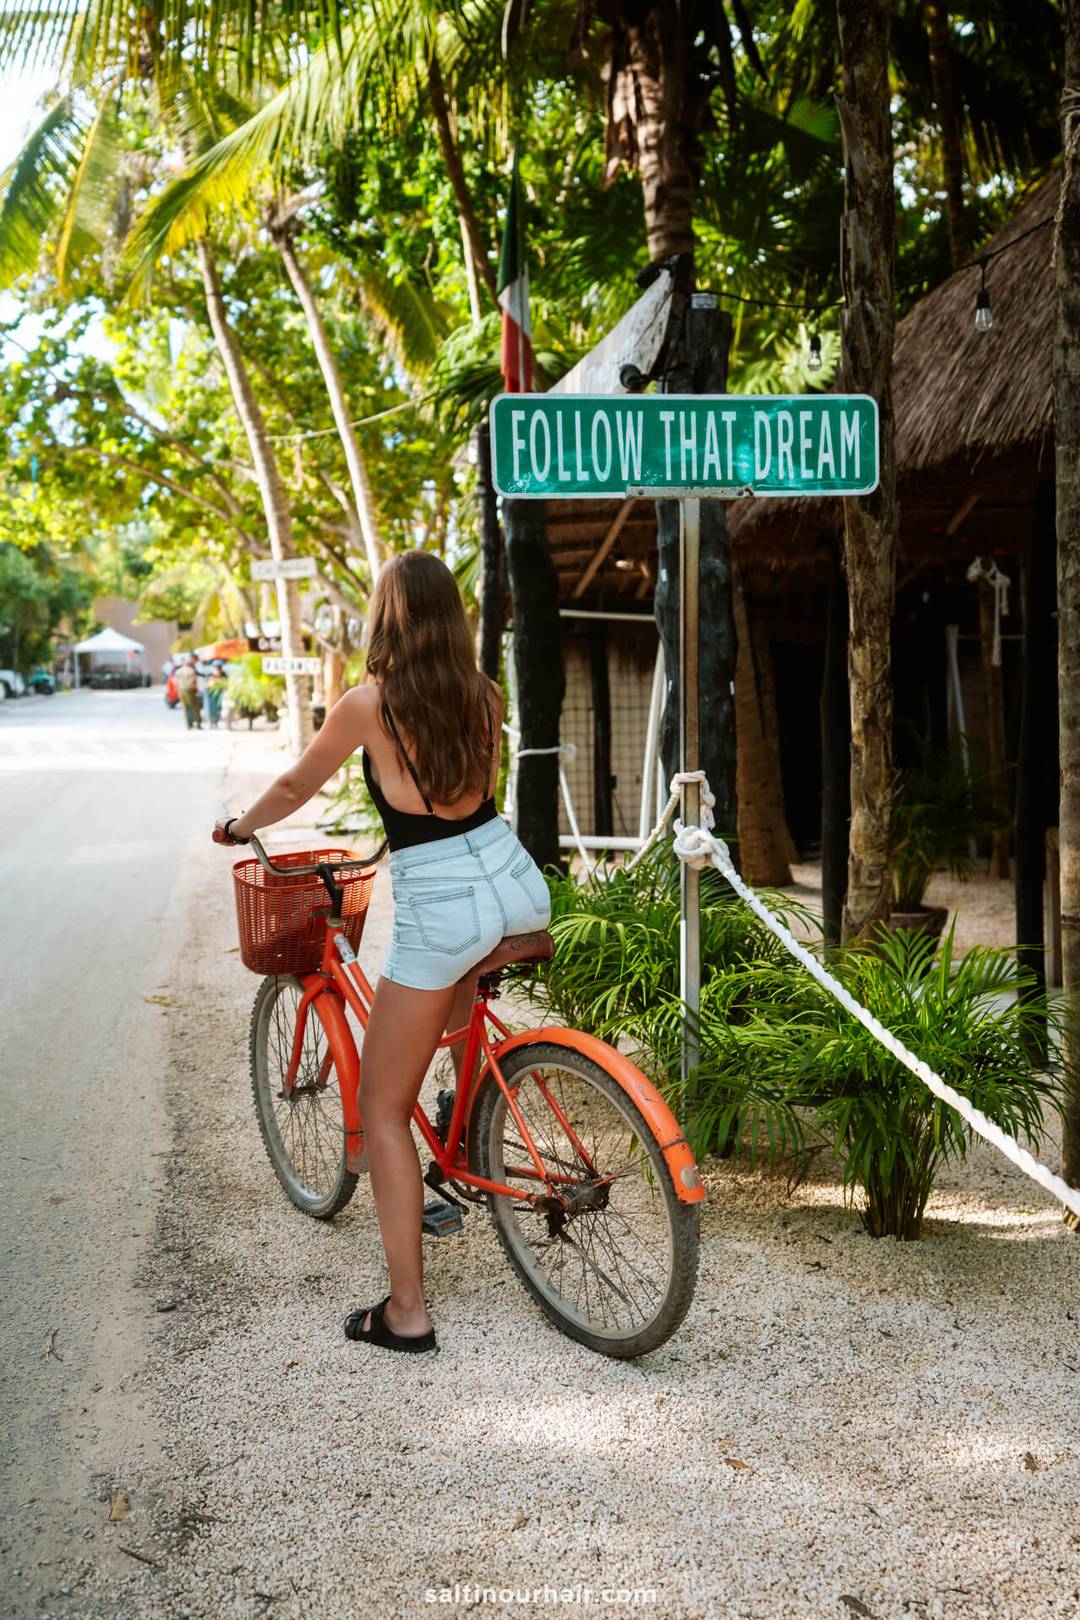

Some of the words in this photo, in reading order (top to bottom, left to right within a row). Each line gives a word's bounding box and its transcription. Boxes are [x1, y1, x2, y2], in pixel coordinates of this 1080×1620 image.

[511, 409, 644, 482] FOLLOW
[659, 410, 737, 481] THAT
[754, 410, 861, 481] DREAM
[266, 659, 318, 671] VACANCY
